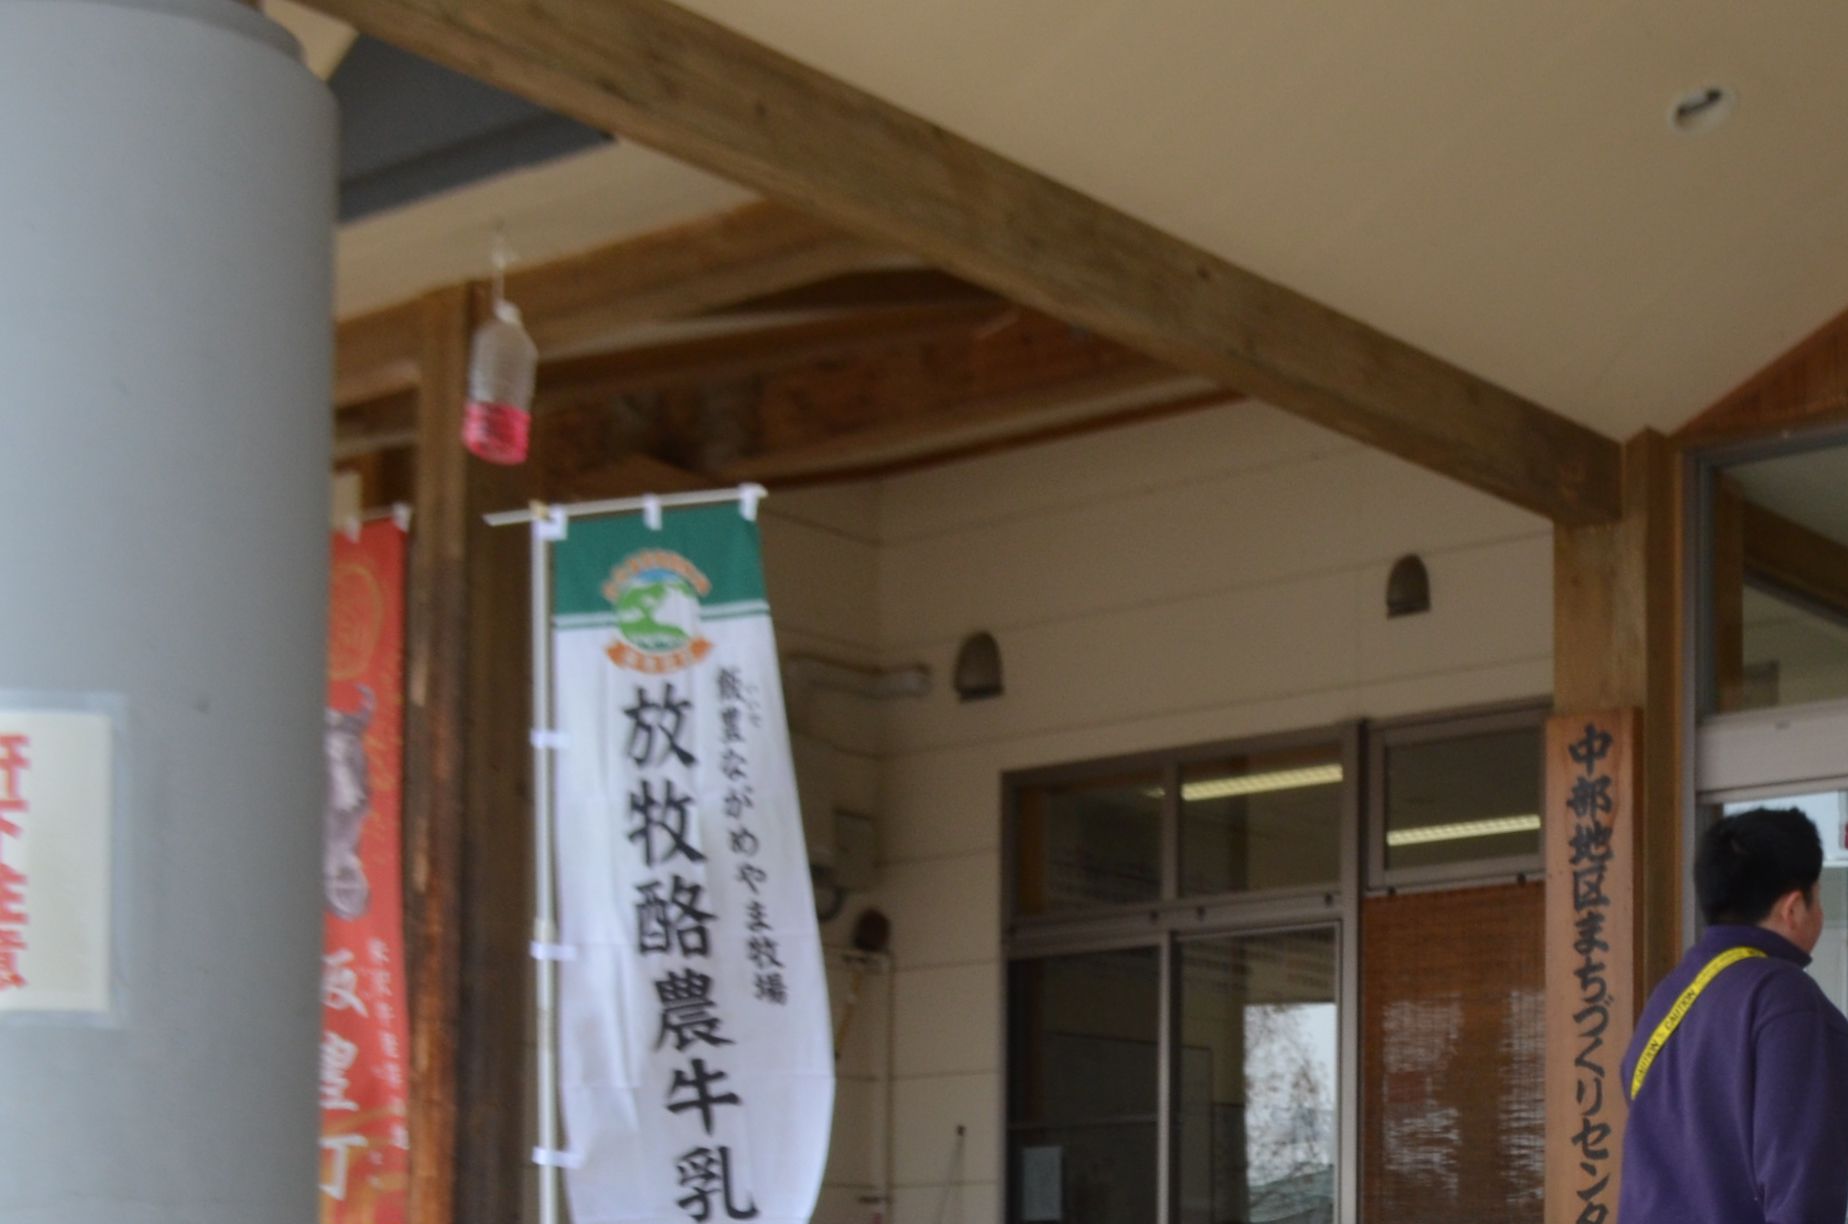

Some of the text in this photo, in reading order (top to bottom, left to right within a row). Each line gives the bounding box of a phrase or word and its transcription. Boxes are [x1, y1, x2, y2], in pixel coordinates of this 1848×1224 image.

[624, 683, 760, 1223] 放牧酪農牛乳
[1664, 989, 1696, 1030] CAUTION
